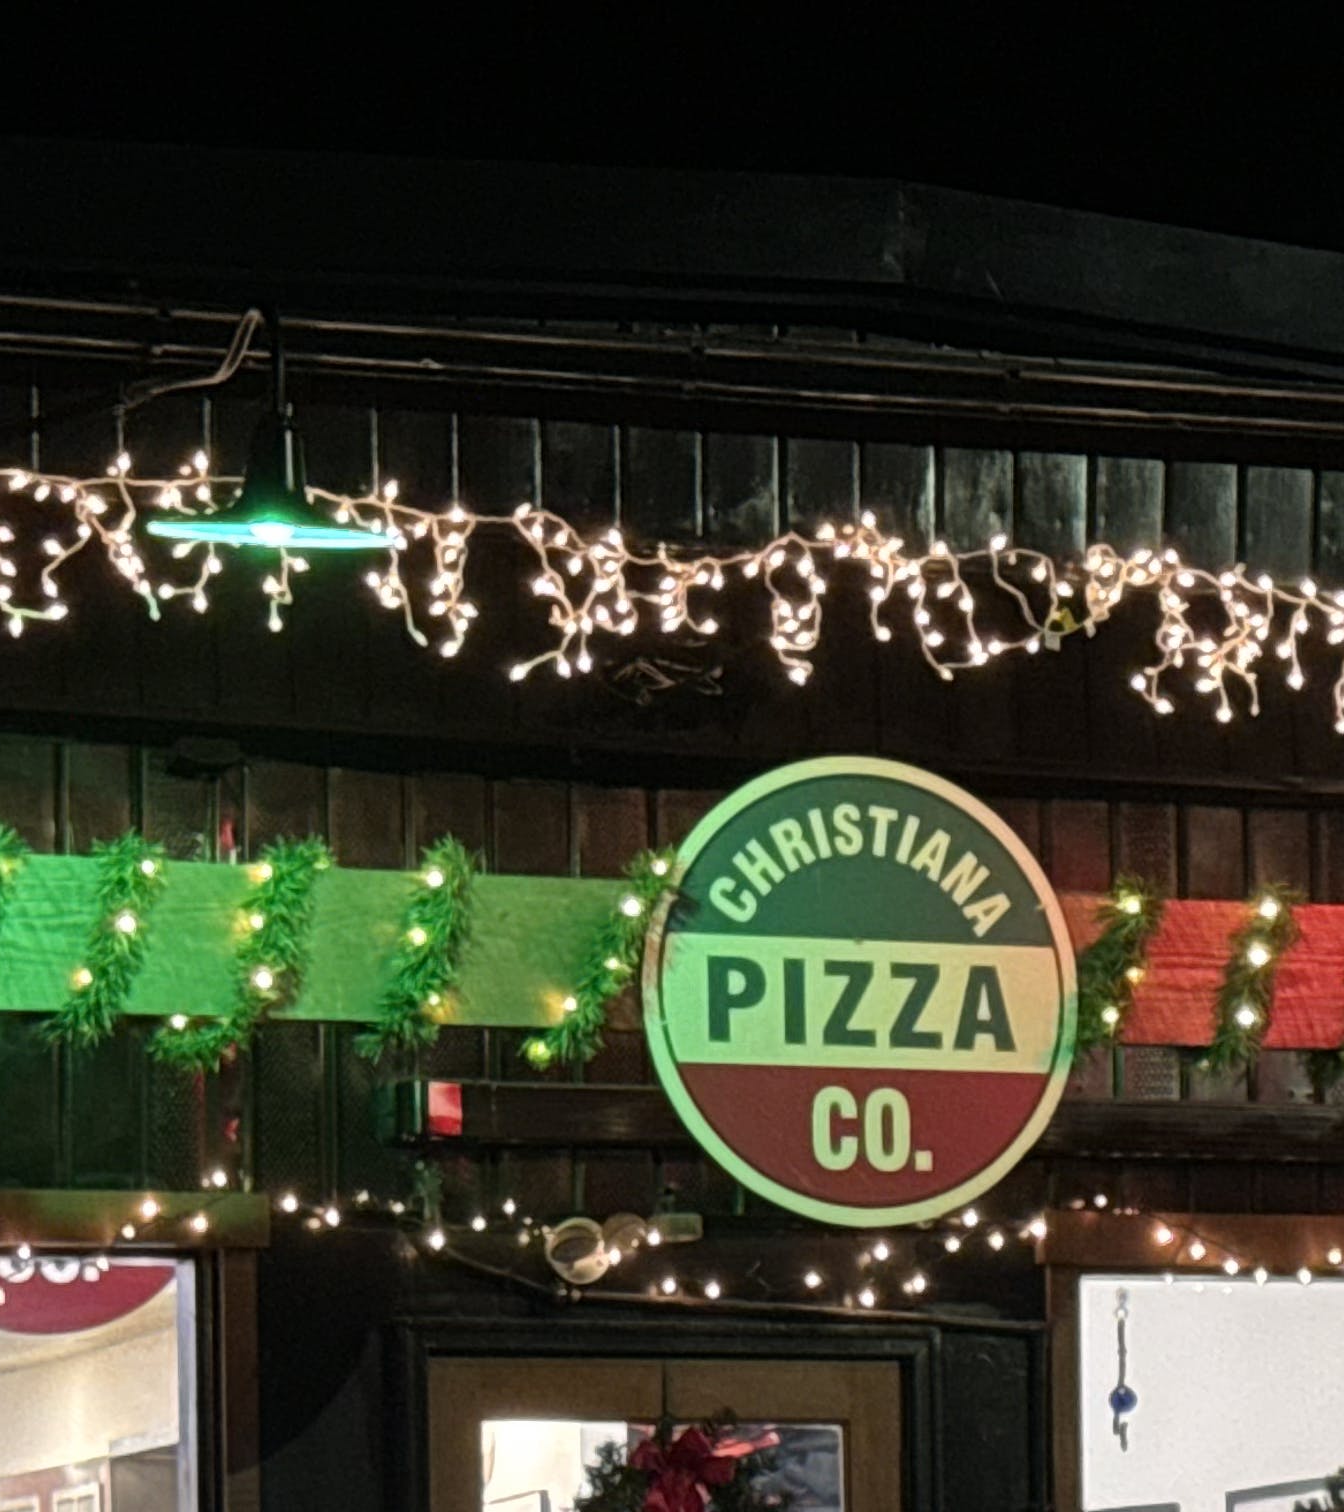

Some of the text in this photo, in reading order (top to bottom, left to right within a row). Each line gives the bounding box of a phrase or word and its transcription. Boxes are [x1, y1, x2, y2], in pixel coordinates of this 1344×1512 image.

[709, 803, 1012, 937] CHRISTIANA
[707, 955, 1017, 1053] PIZZA
[811, 1085, 933, 1172] CO.
